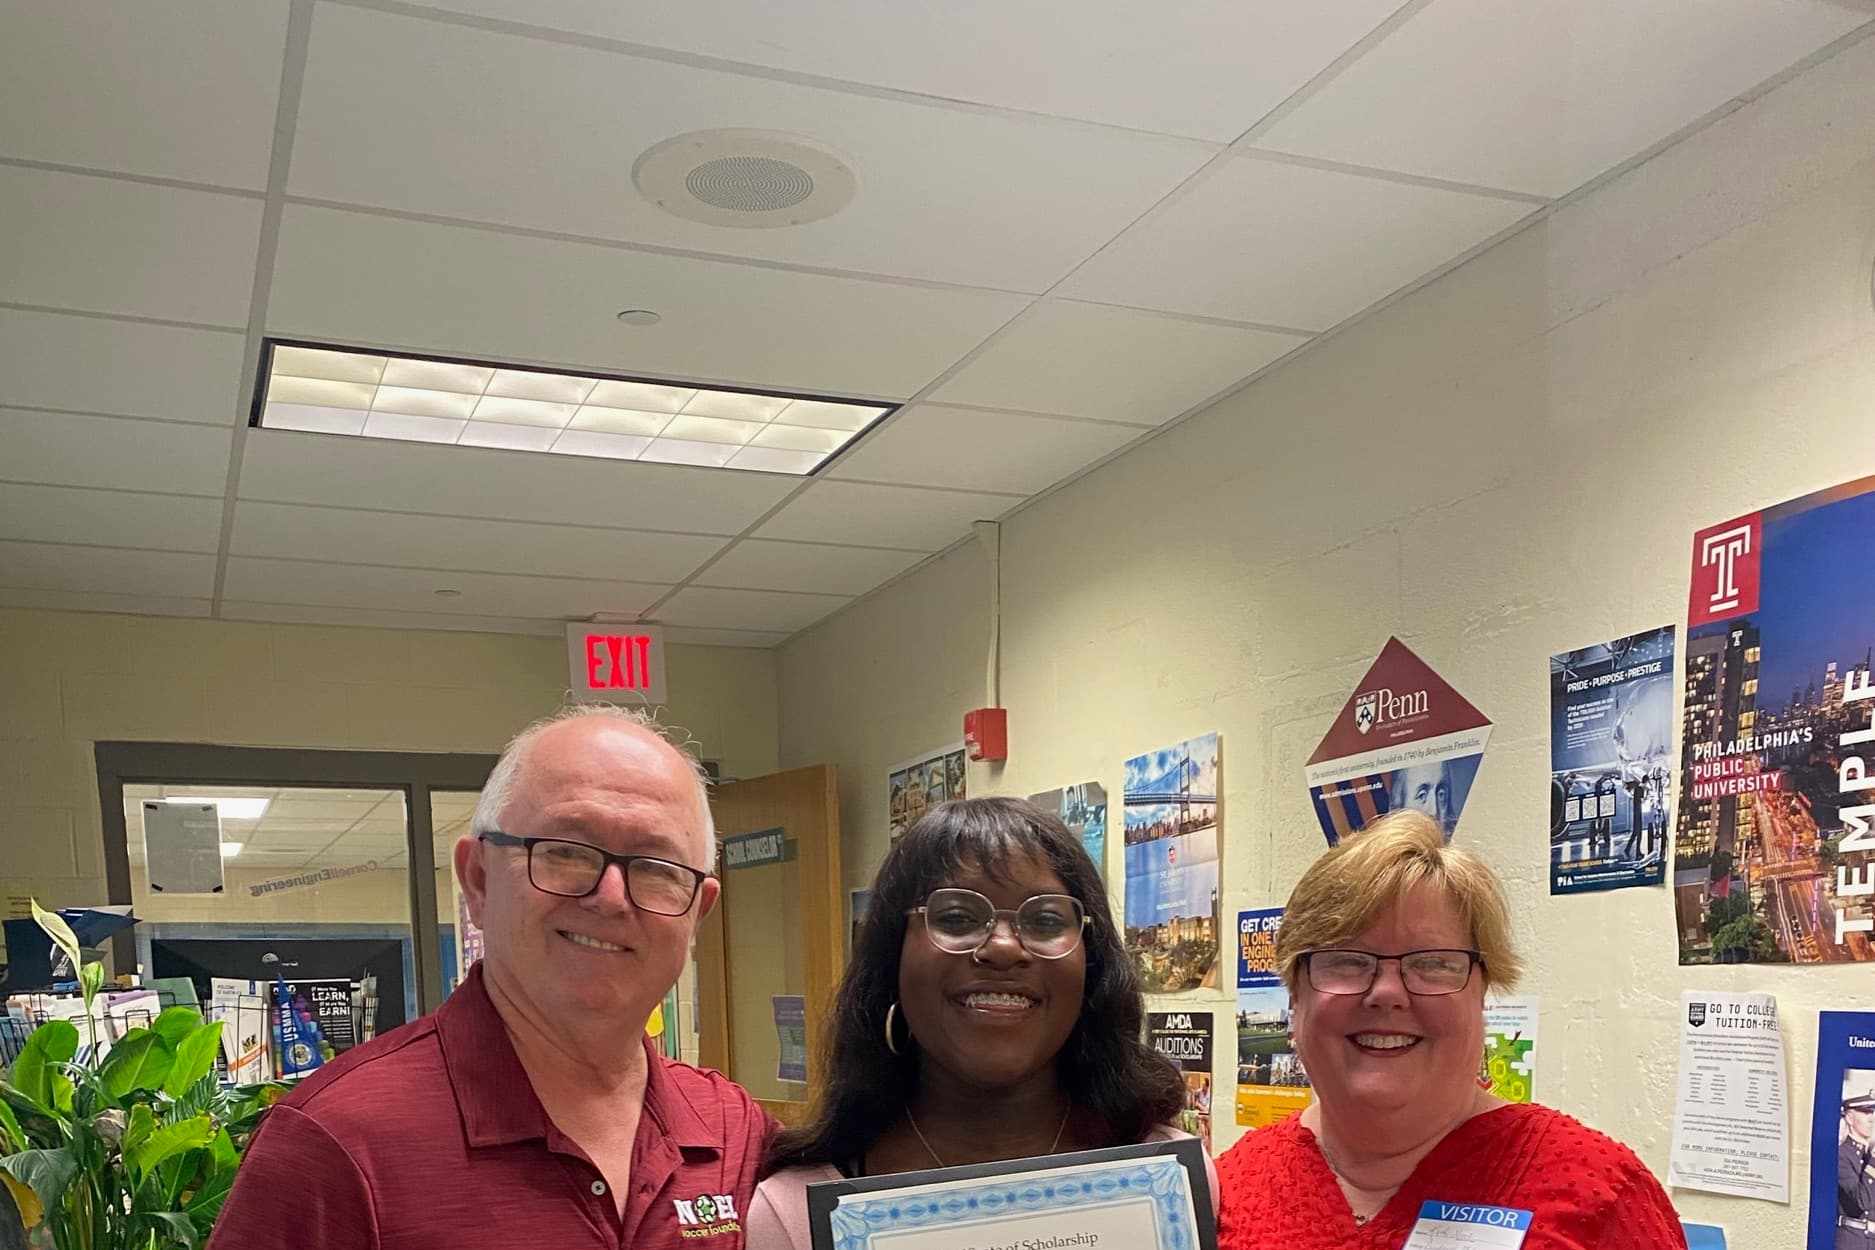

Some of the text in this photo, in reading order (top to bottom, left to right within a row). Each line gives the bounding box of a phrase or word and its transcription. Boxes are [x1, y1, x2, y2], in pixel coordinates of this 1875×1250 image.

[585, 635, 651, 690] EXIT
[1567, 662, 1662, 693] PRIDE PURPOSE PRESTIGE
[1376, 688, 1430, 723] Penn
[1694, 726, 1814, 761] PHILADELPHIA'S
[1694, 758, 1744, 780] PUBLIC
[1693, 773, 1780, 799] UNIVERSITY
[1241, 918, 1260, 933] GET
[1240, 933, 1249, 946] IN
[1251, 931, 1272, 945] ONE
[312, 991, 349, 1002] LEARN,
[1709, 1003, 1722, 1014] GO
[1729, 1004, 1740, 1014] TO
[281, 1002, 299, 1042] USMMA
[1165, 1014, 1193, 1029] AMDA
[1155, 1037, 1204, 1054] AUDITIONS
[673, 1194, 738, 1225] NOEL
[1440, 1205, 1519, 1228] VISITOR
